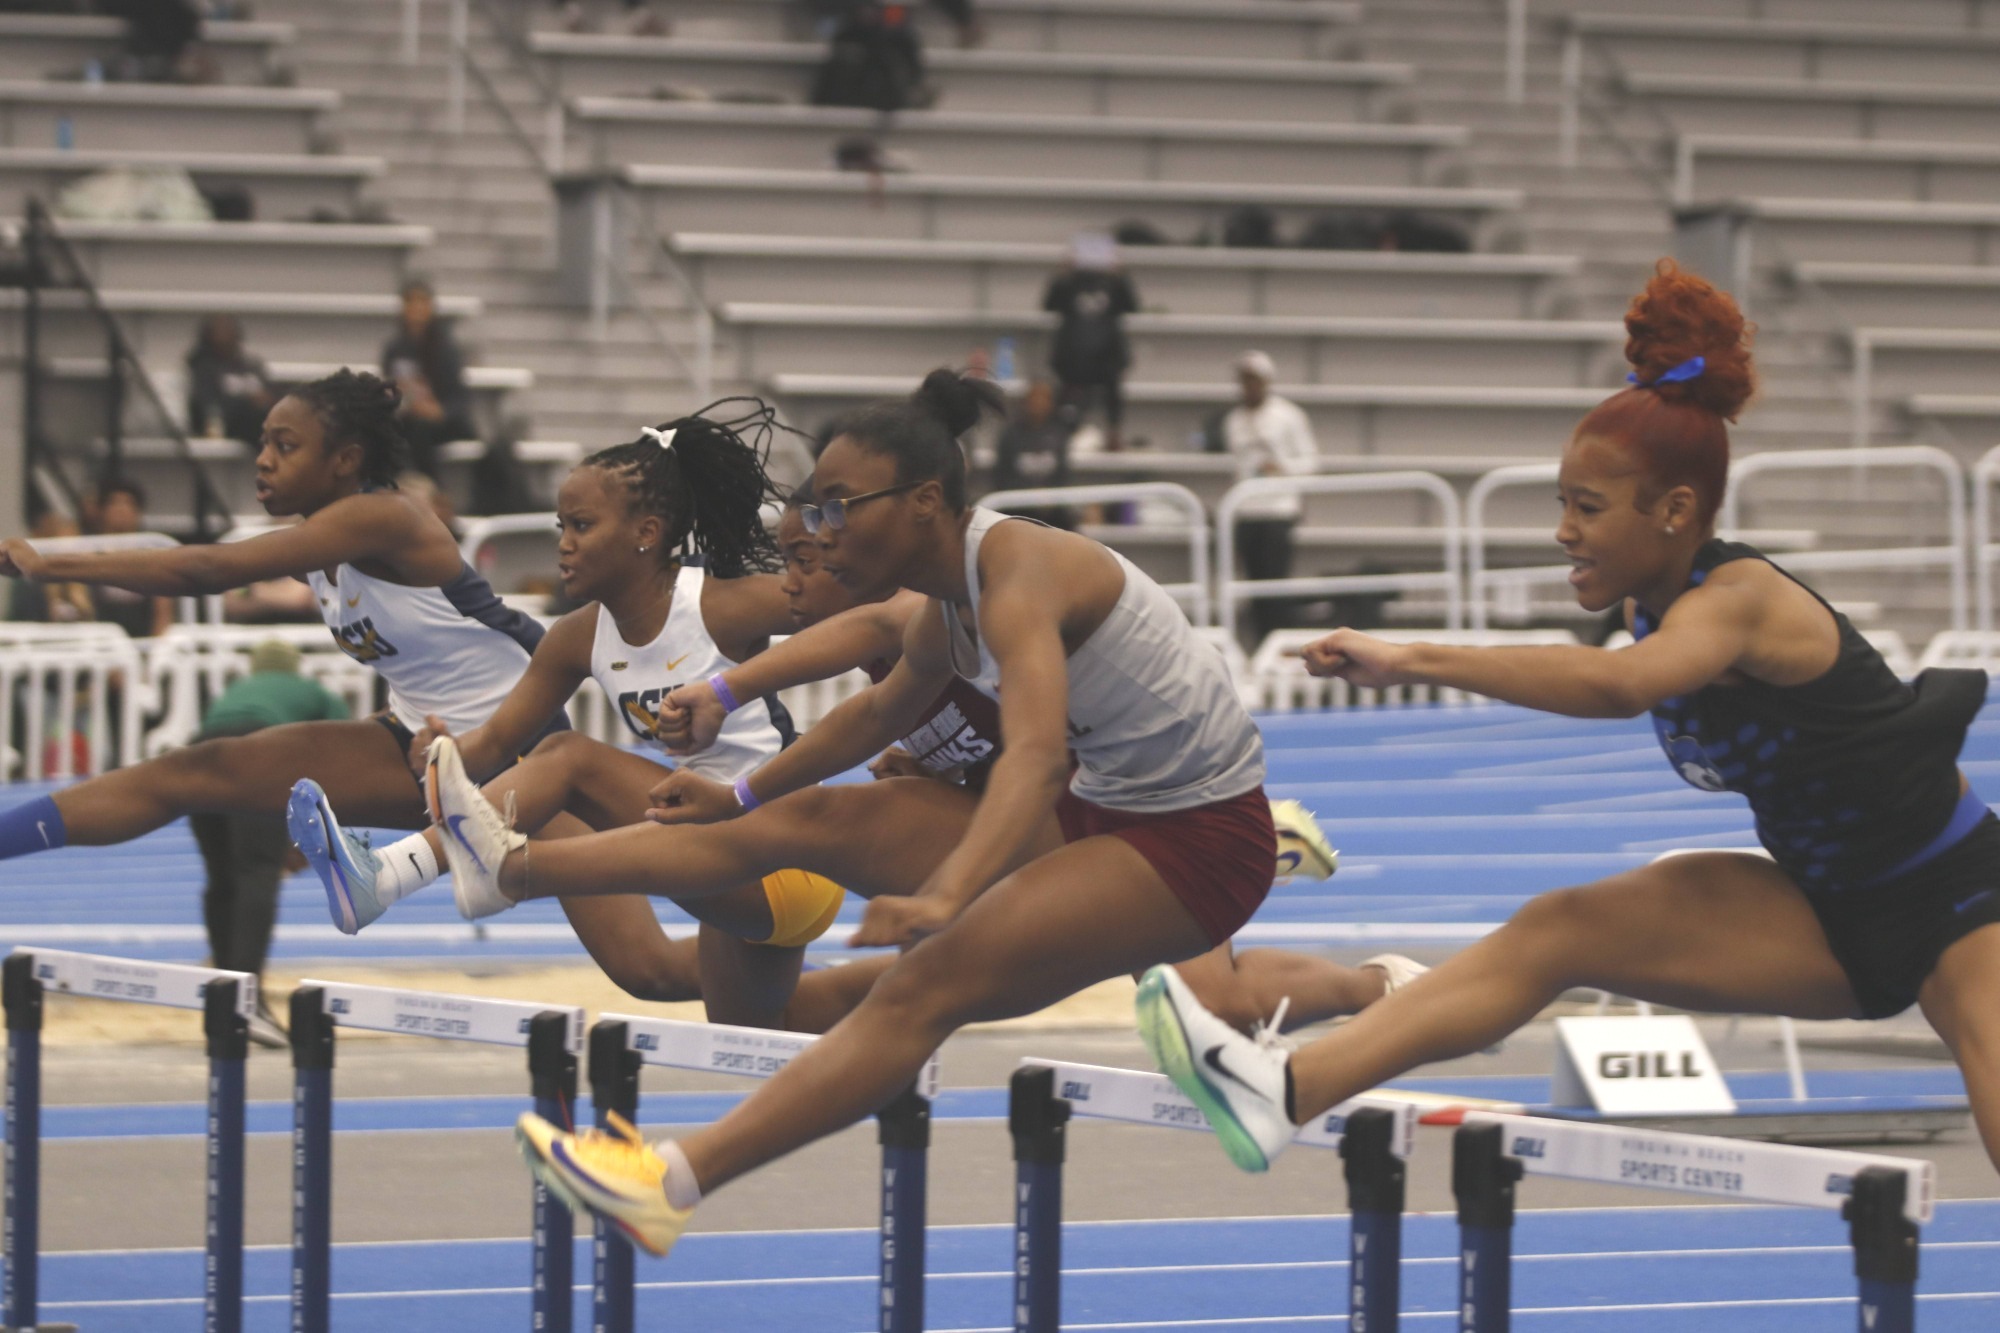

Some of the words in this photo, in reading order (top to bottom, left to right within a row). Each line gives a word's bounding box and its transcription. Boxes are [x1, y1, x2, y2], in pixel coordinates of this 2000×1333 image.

[712, 1051, 755, 1070] SPORTS
[1599, 1052, 1703, 1079] GILL
[1060, 1080, 1092, 1101] GILL
[1152, 1102, 1201, 1125] SPORTS
[1511, 1136, 1547, 1158] GILL
[1620, 1159, 1677, 1184] SPORTS
[1683, 1166, 1743, 1191] CENTER
[1016, 1182, 1032, 1333] VIRGIN
